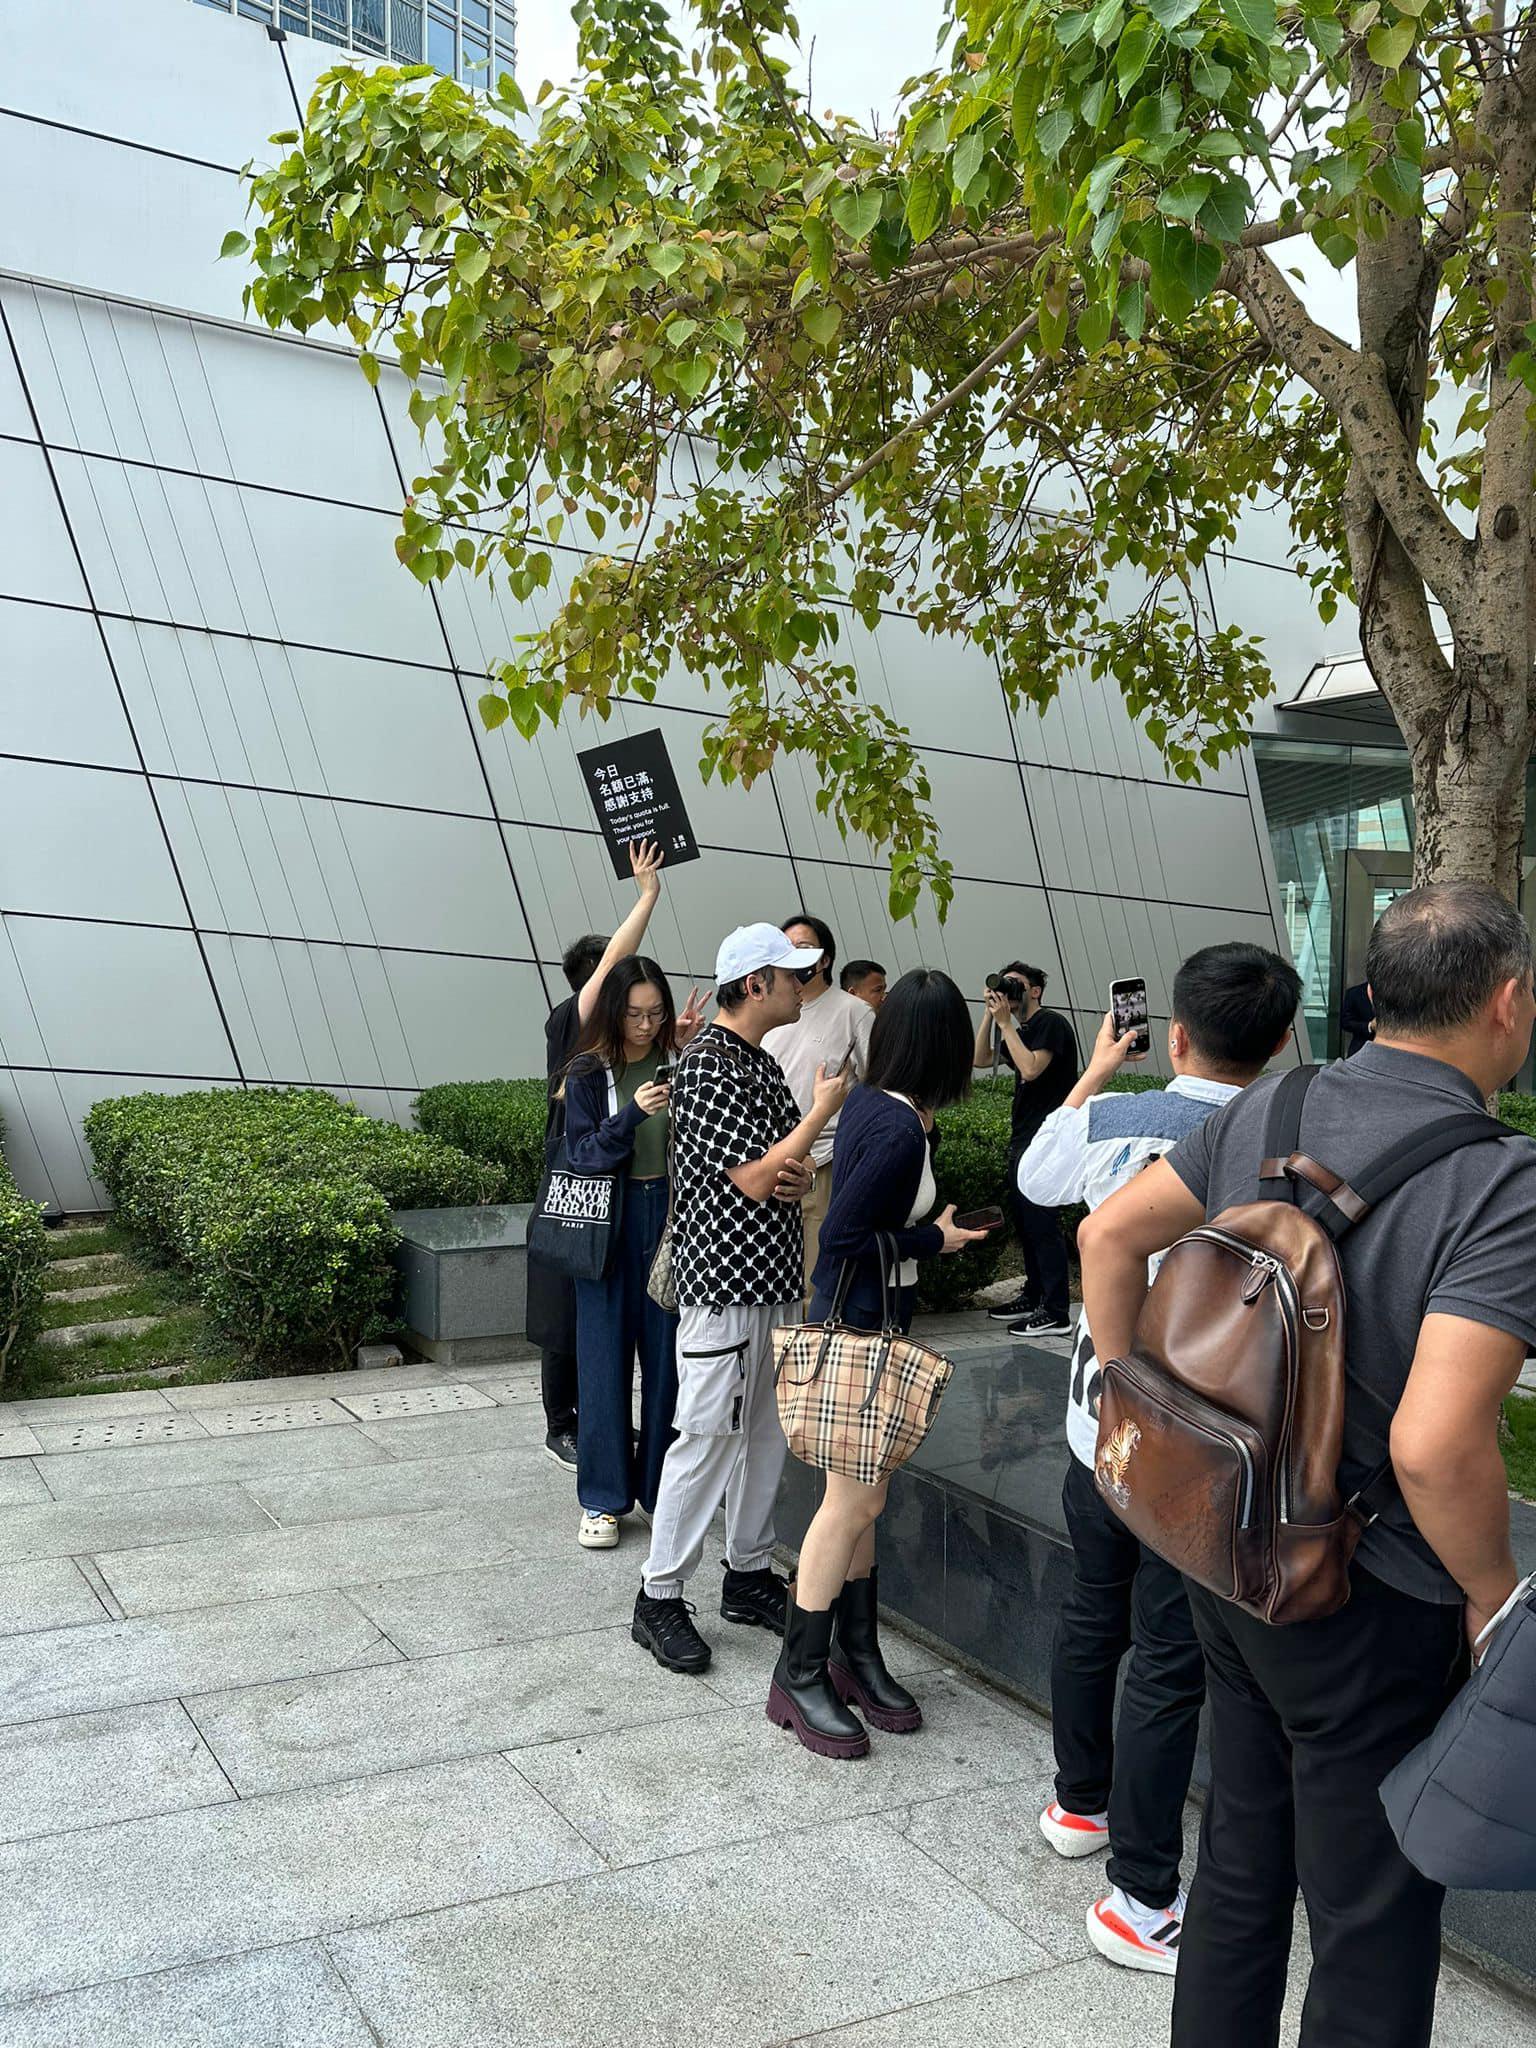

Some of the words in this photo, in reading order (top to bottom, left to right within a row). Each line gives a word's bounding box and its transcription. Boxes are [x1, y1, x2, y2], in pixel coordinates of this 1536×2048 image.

[594, 764, 619, 781] 今日
[604, 787, 654, 812] 感謝支持
[610, 814, 633, 825] Today's
[634, 809, 652, 818] quota
[613, 824, 633, 835] Thank
[632, 821, 645, 831] you
[616, 836, 631, 846] your
[544, 1200, 609, 1219] GIRBAUD
[561, 1221, 584, 1229] PARIS
